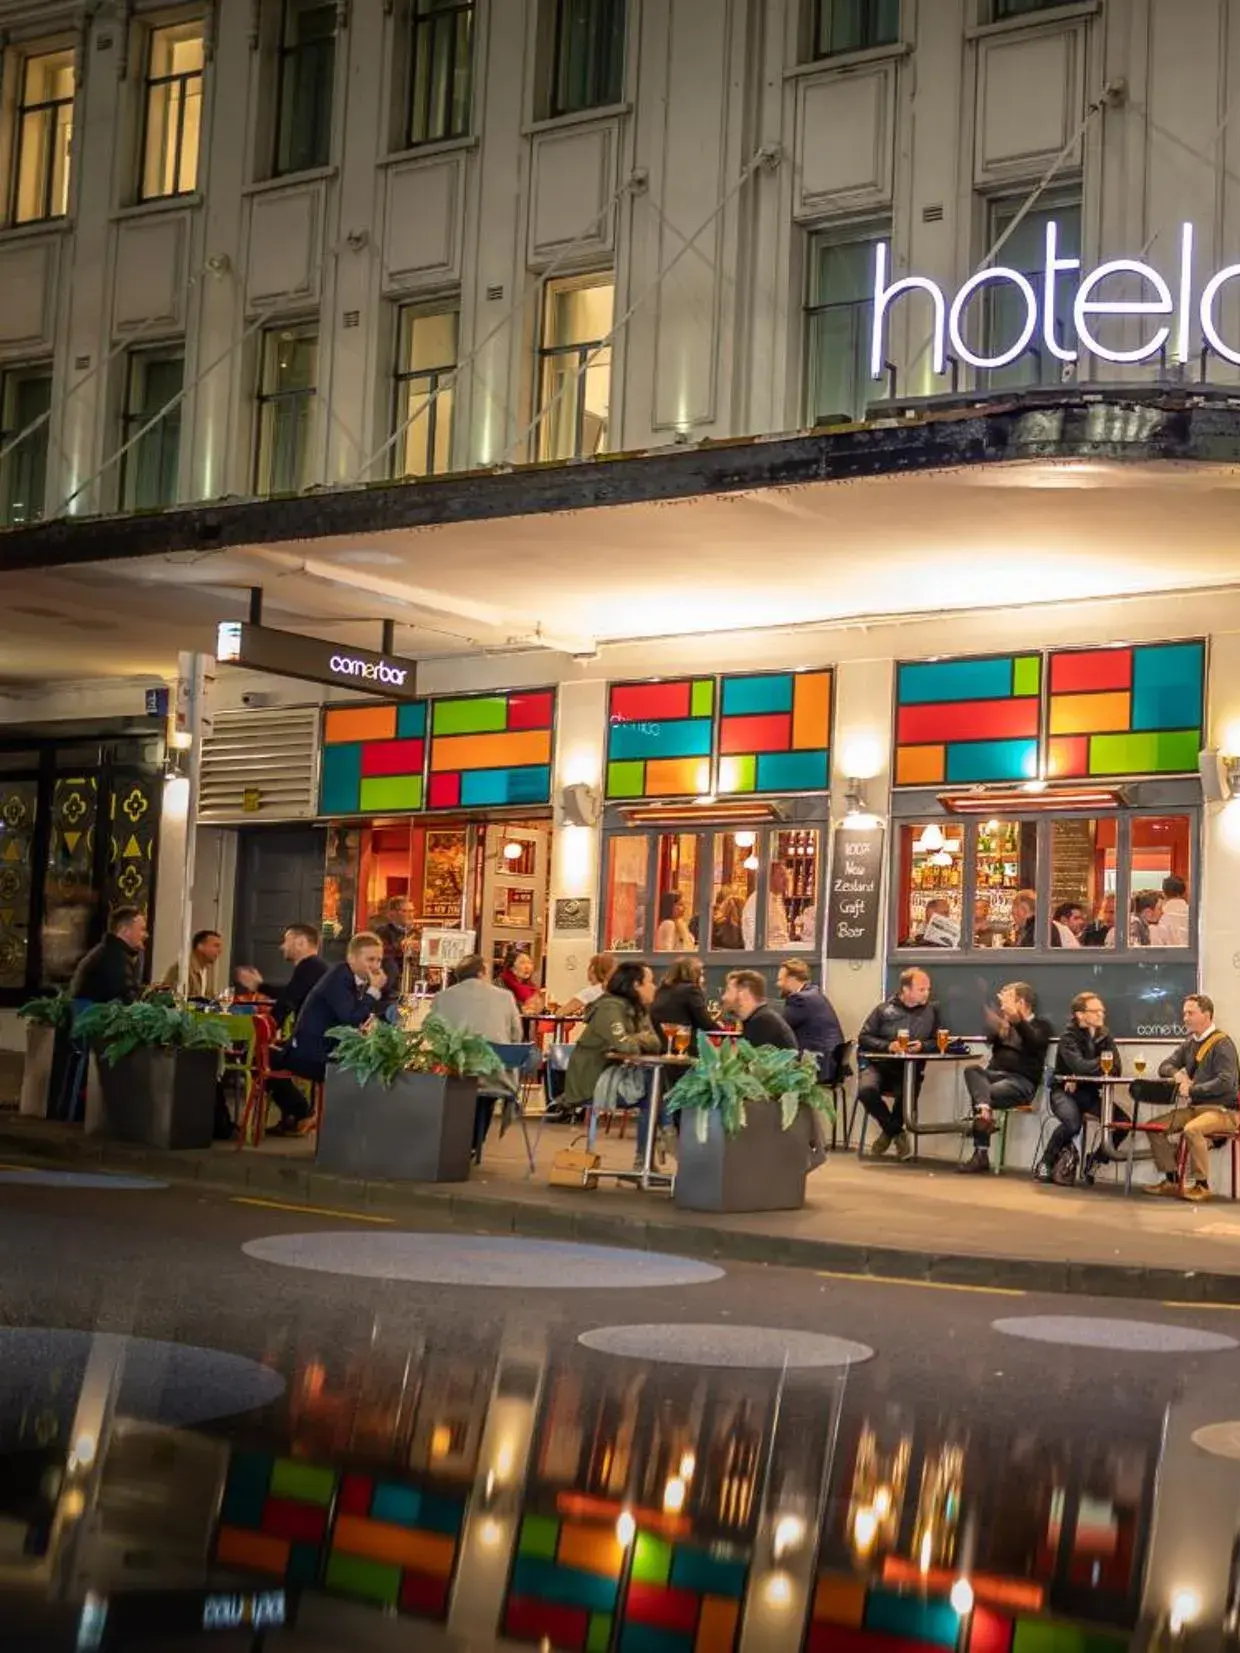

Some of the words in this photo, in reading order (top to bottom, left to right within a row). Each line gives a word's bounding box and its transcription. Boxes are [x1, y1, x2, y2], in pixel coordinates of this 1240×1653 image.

[330, 656, 408, 685] cornerbar
[845, 842, 871, 856] 100%
[845, 861, 866, 875] New
[834, 879, 875, 892] Zealand
[839, 898, 866, 919] Craft
[837, 921, 866, 938] Beer
